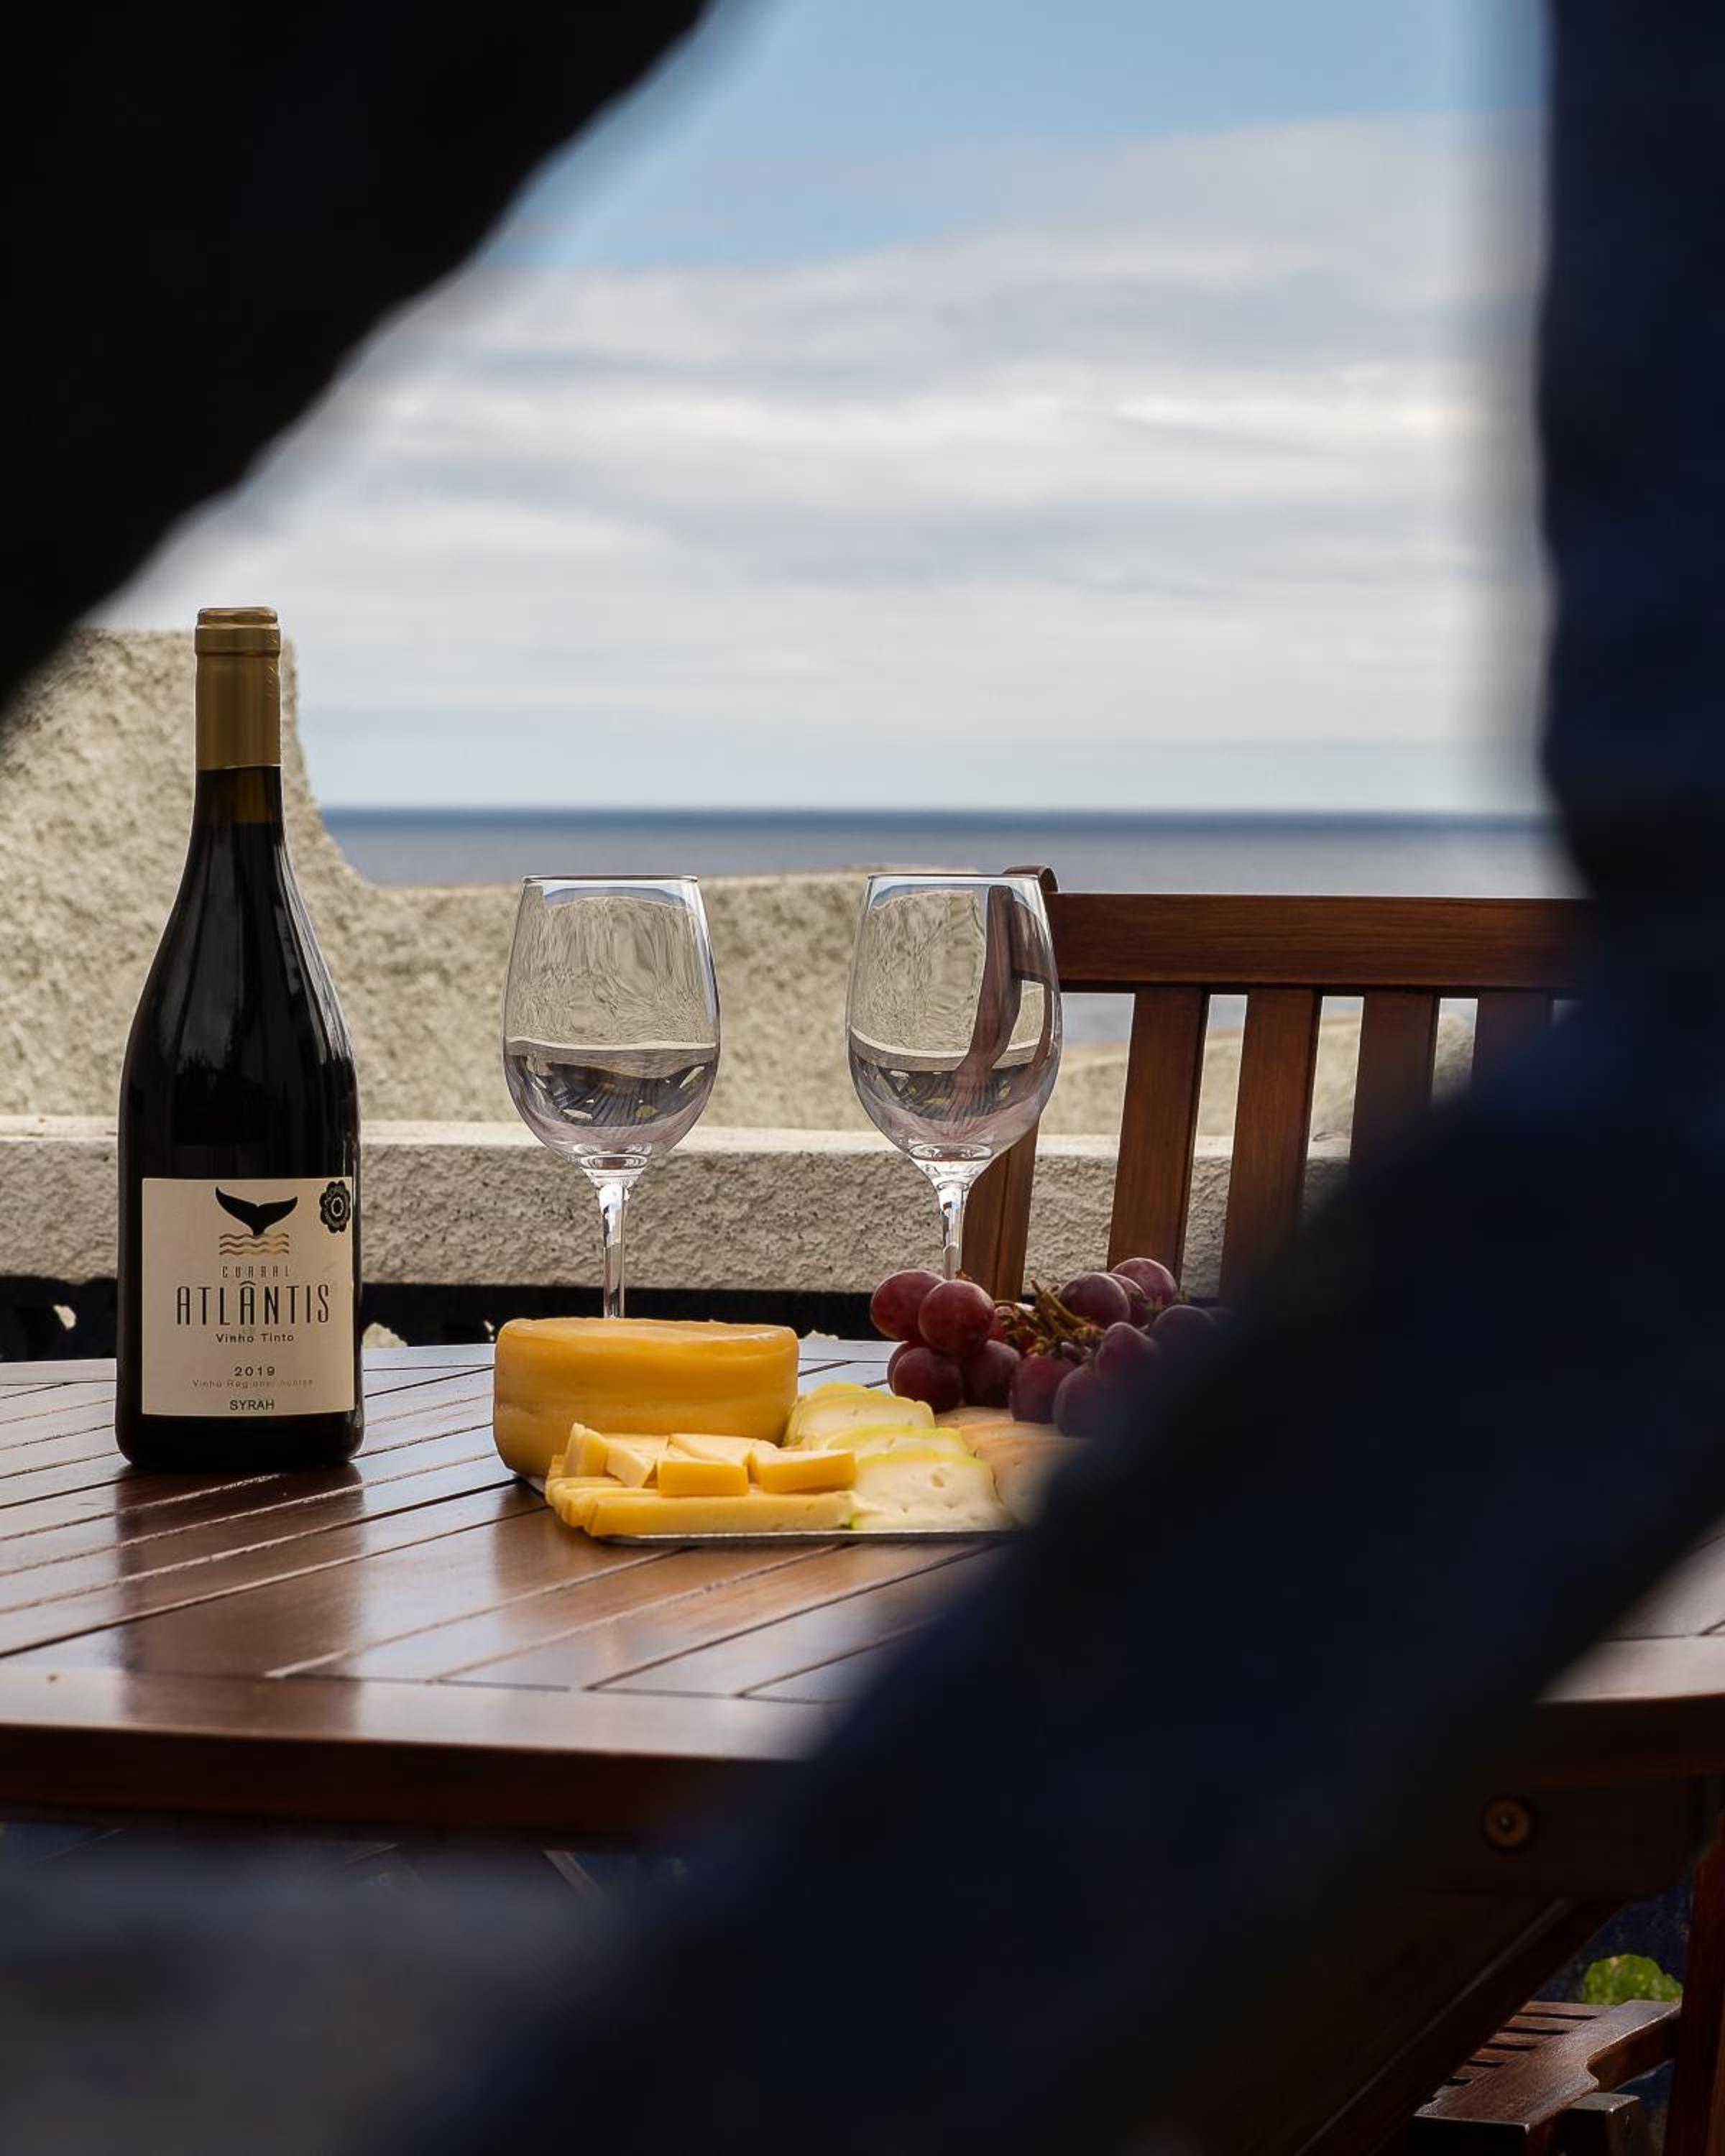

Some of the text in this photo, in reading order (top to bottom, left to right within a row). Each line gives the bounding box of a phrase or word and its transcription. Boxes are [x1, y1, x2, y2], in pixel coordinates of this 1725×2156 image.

[177, 1281, 329, 1326] ATLÂNTIS
[216, 1332, 294, 1344] Vinho Tinto
[234, 1366, 275, 1377] 2019
[227, 1379, 273, 1389] Regon
[229, 1399, 275, 1411] SYRAH
